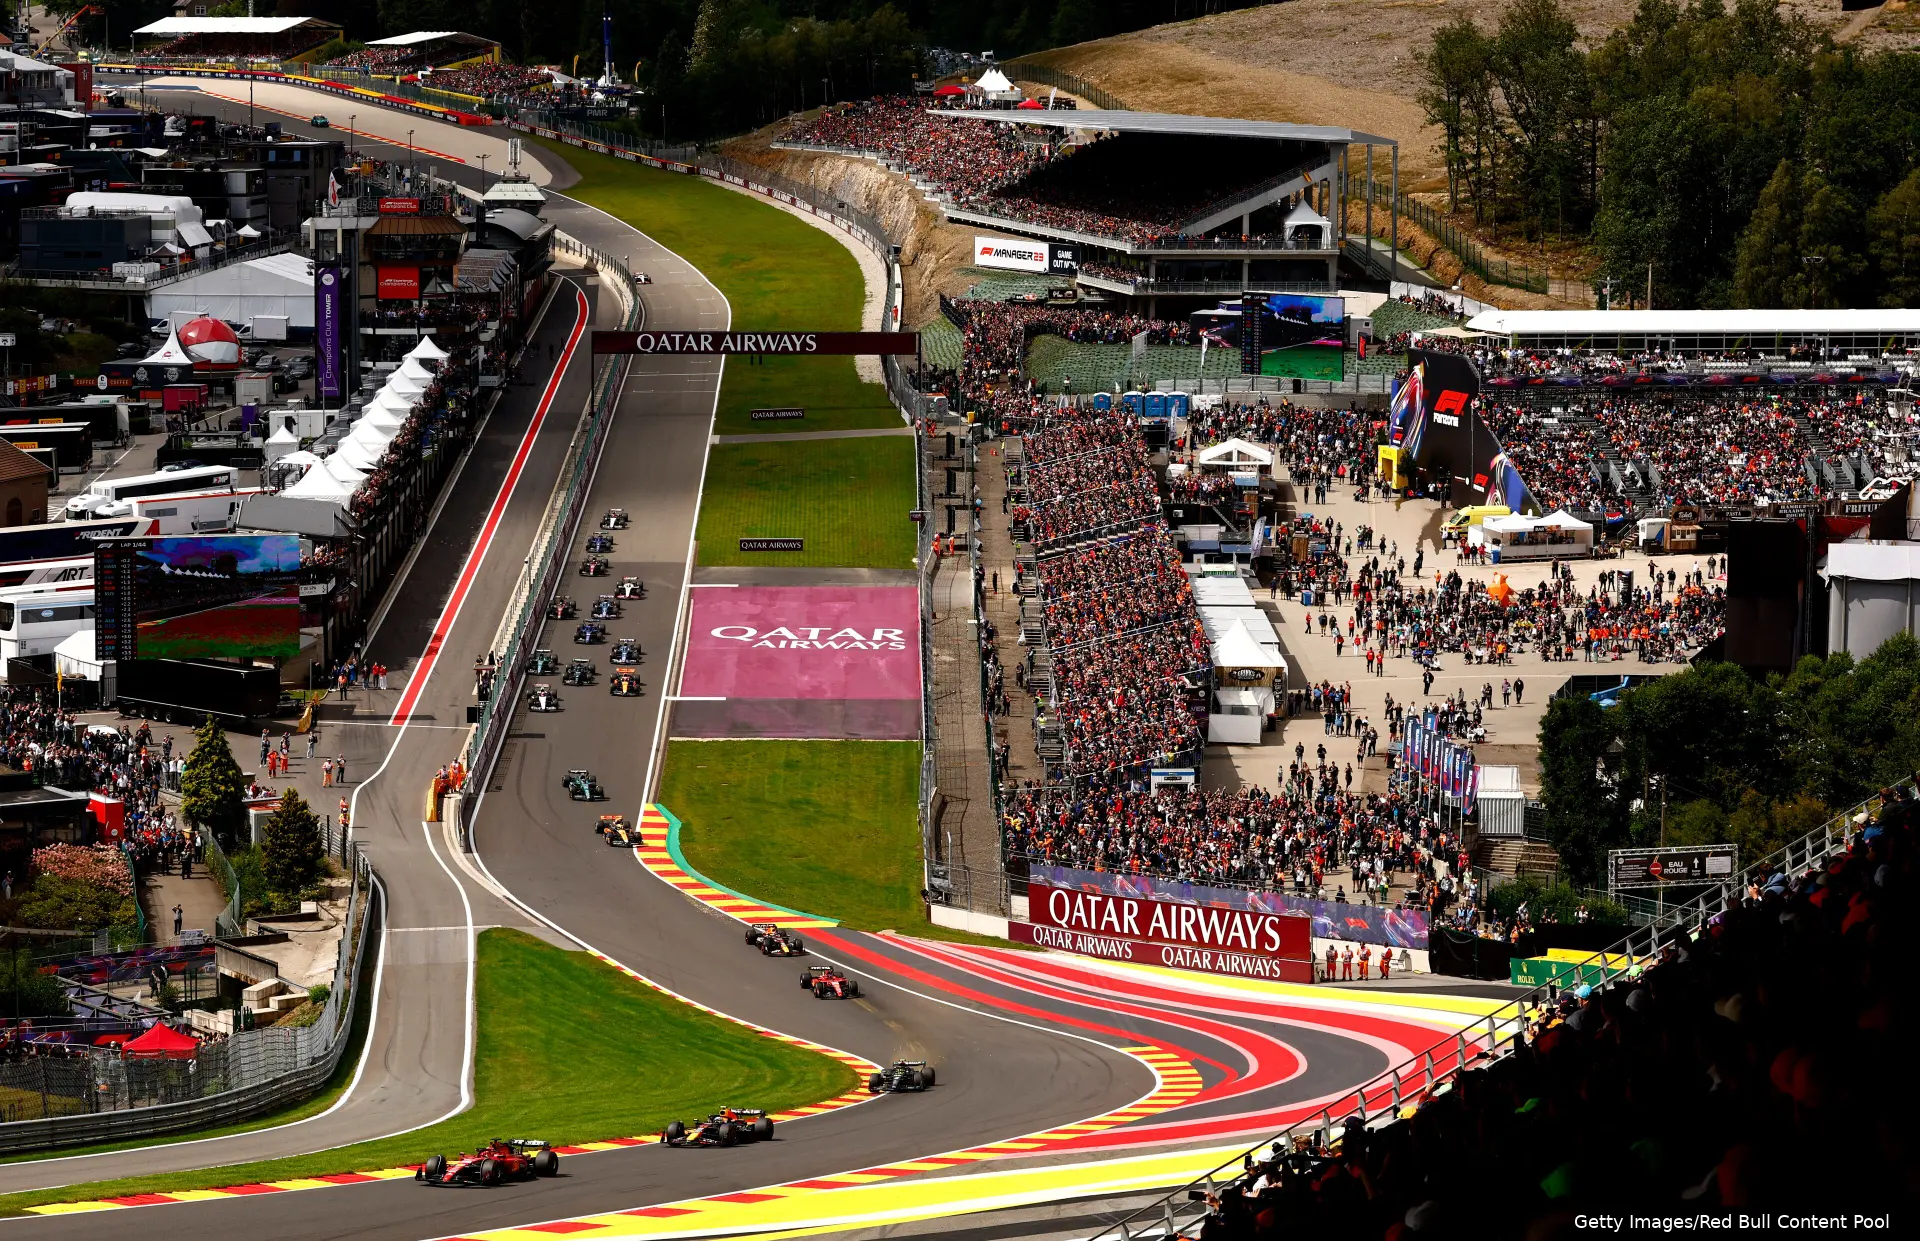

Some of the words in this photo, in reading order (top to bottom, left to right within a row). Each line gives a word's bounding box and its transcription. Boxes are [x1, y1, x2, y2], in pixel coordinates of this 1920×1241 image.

[994, 249, 1033, 261] MANAGER
[1034, 252, 1044, 262] 23
[1057, 251, 1072, 260] GAME
[636, 334, 714, 353] QATAR
[720, 334, 817, 352] AIRWAYS
[752, 411, 774, 419] QATAR
[775, 410, 803, 418] AIRWAYS
[741, 541, 767, 549] QATAR
[769, 541, 801, 549] AIRWAYS
[53, 566, 89, 582] ART
[710, 625, 905, 642] QATAR
[752, 640, 906, 650] AIRWAYS
[1663, 867, 1688, 875] ROUGE
[1049, 889, 1141, 936] QATAR
[1148, 902, 1281, 952] AIRWAYS
[1033, 926, 1074, 950] QATAR
[1075, 935, 1133, 959] AIRWAYS
[1161, 946, 1212, 970] QATAR
[1215, 955, 1281, 978] AIRWAYS
[1517, 975, 1536, 984] ROLEX
